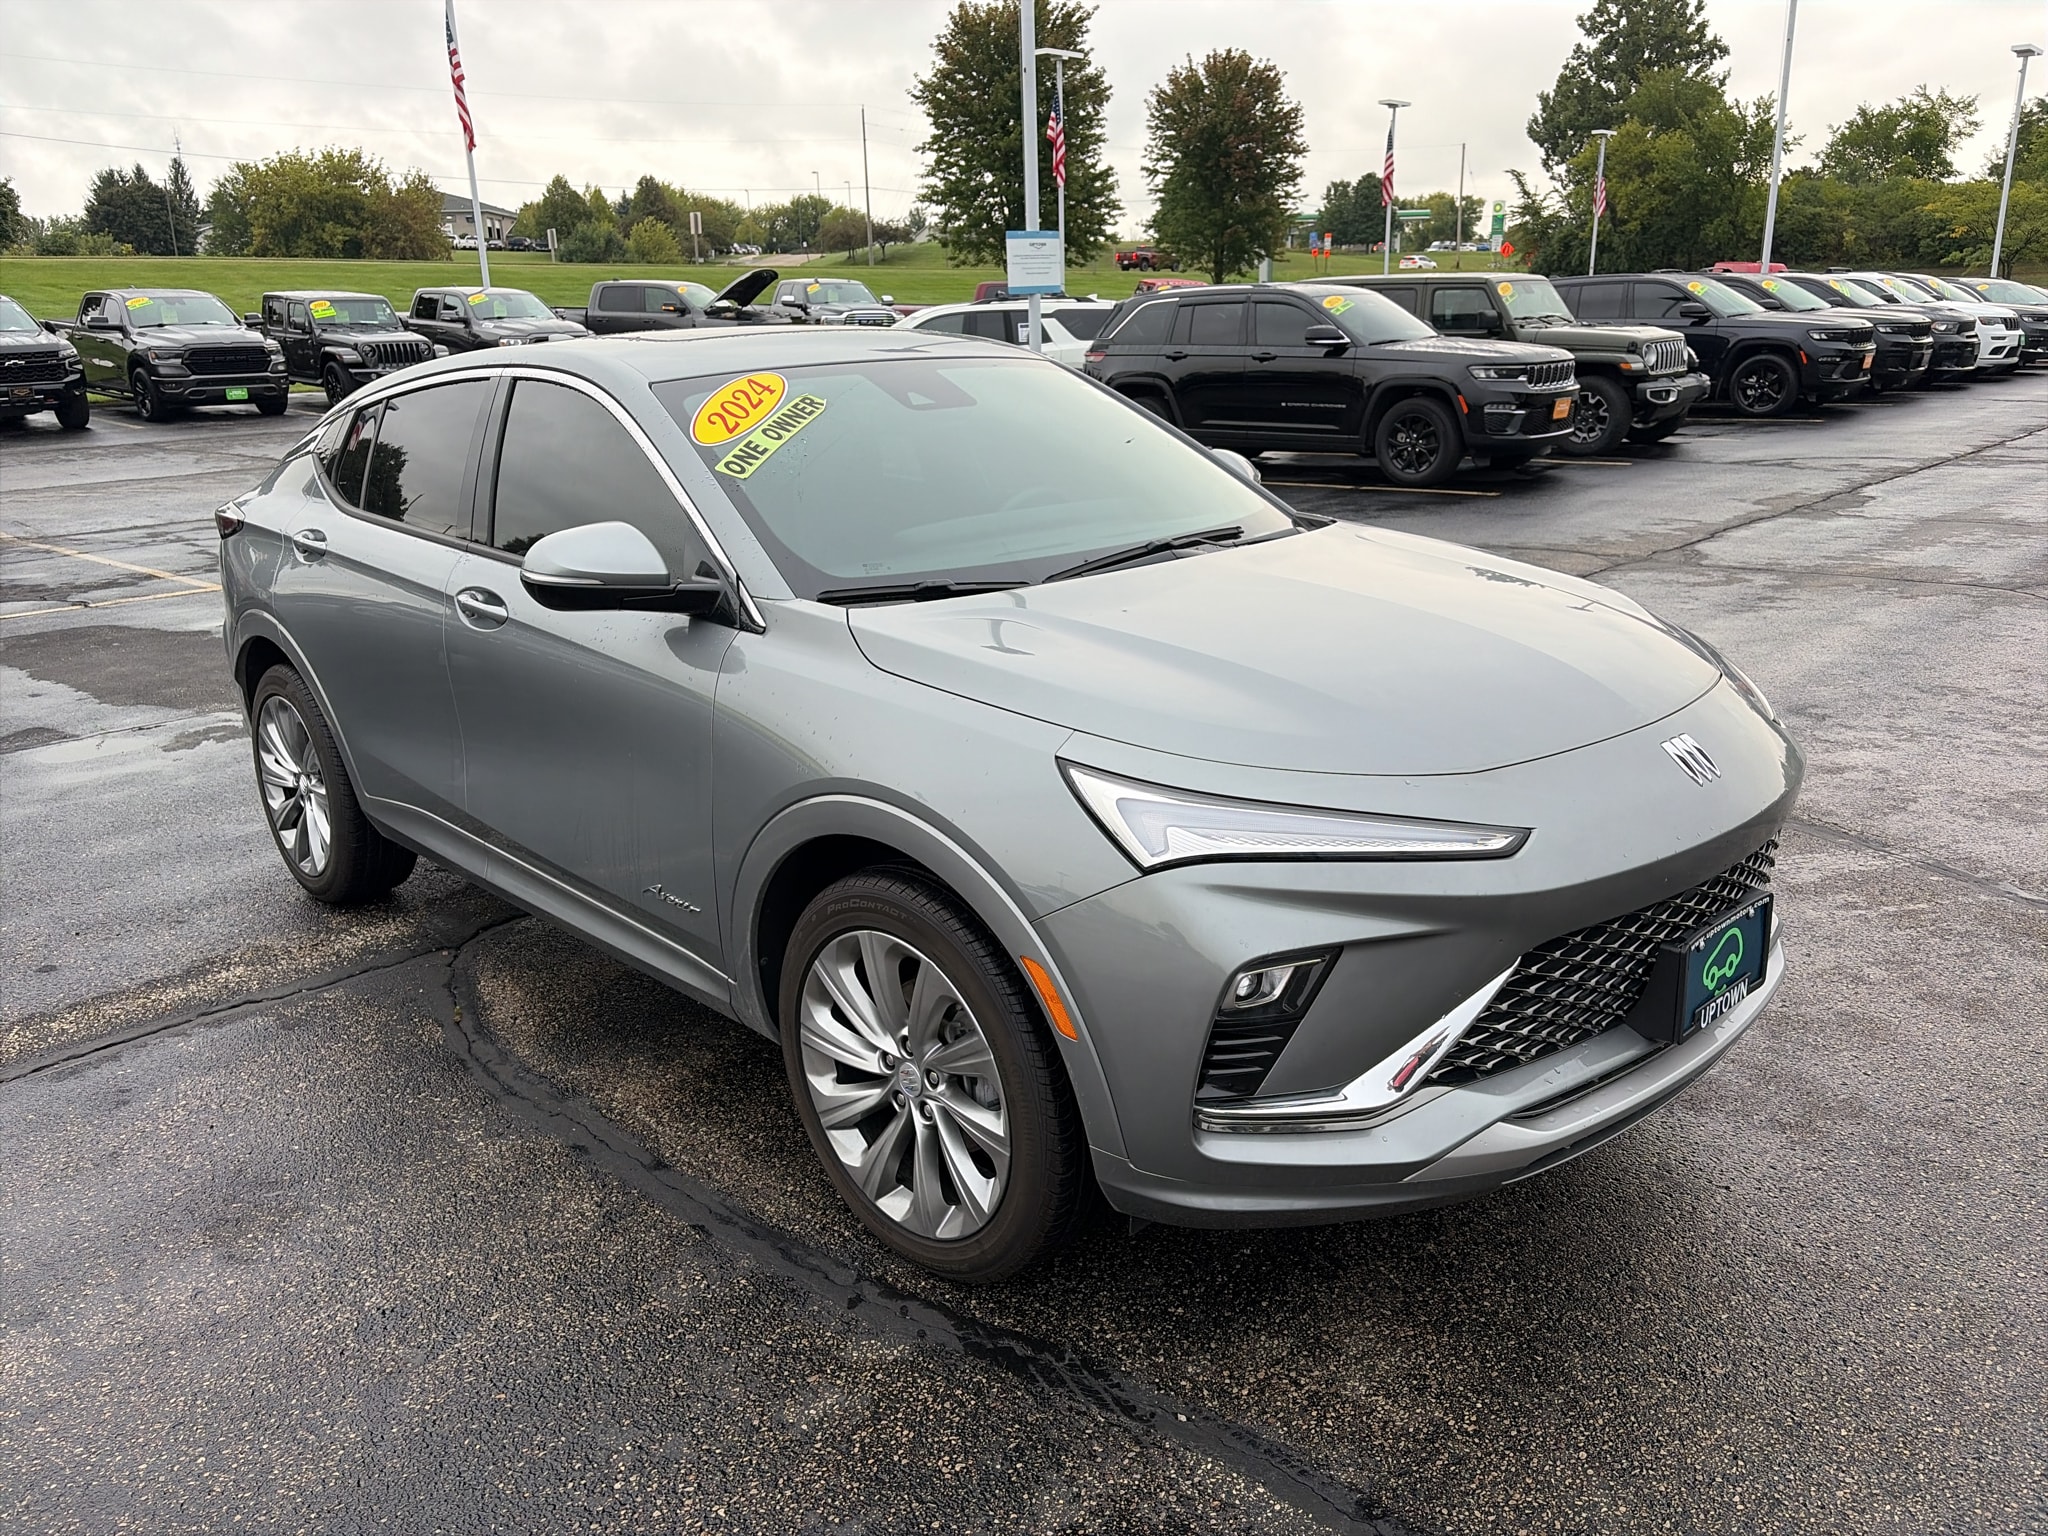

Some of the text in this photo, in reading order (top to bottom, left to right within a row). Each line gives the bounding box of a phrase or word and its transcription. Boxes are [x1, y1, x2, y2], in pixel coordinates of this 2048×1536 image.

[707, 378, 777, 435] 2024
[723, 396, 825, 475] ONE OWNER
[1701, 978, 1749, 1029] UPTOWN
